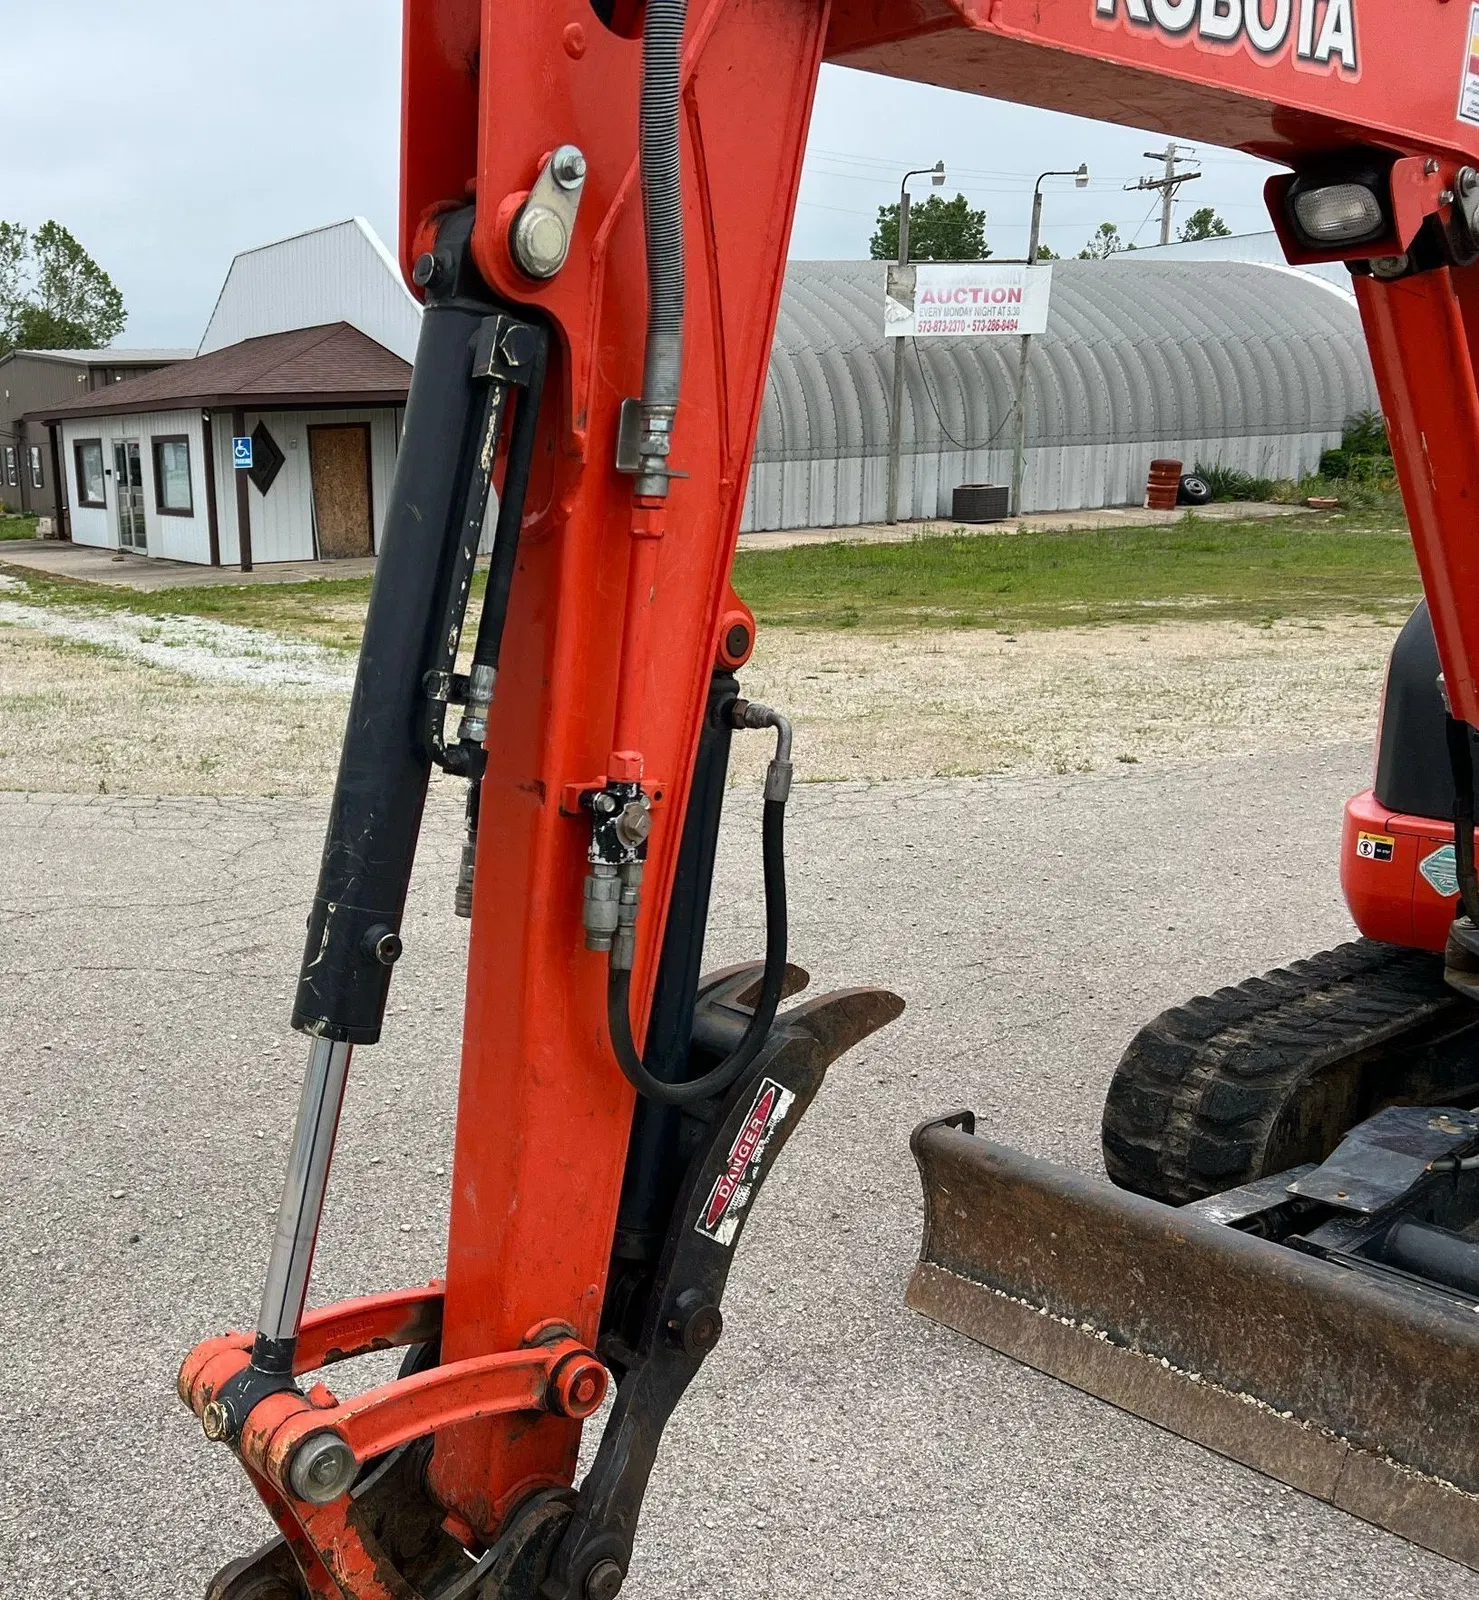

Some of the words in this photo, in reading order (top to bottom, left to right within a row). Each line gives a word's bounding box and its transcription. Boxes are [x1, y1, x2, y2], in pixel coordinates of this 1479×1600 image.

[921, 288, 1022, 304] AUCTION
[919, 307, 942, 318] EVERY
[943, 307, 973, 317] MONDAY
[974, 306, 997, 317] NIGHT
[997, 306, 1007, 317] AT
[917, 320, 966, 333] 573-873-2370
[718, 1118, 763, 1199] DANGER
